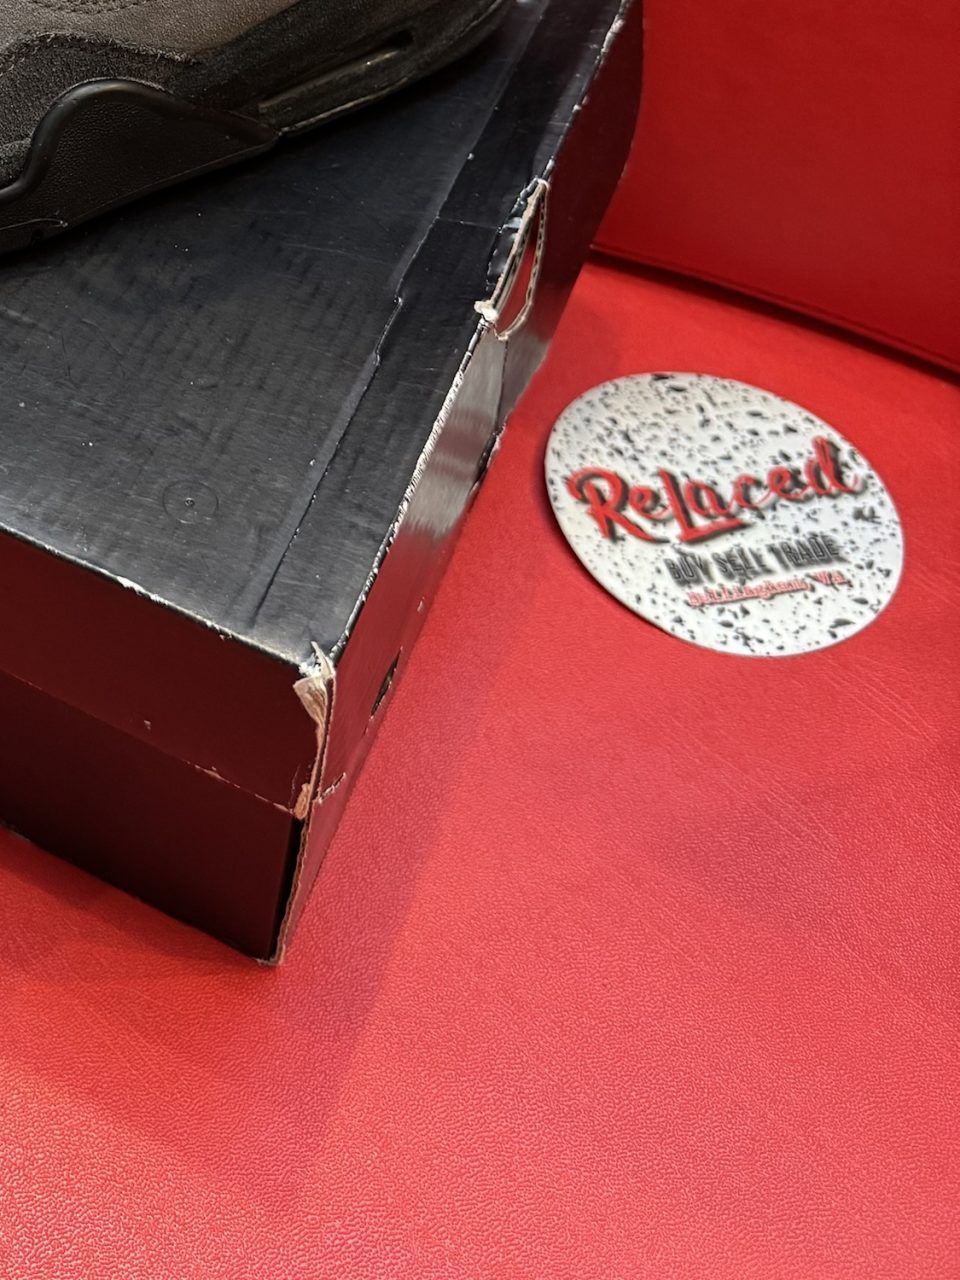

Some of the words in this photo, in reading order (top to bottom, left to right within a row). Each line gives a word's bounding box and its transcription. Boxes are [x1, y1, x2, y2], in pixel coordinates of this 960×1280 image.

[663, 554, 709, 586] BUY
[711, 547, 772, 579] SELL
[766, 535, 843, 567] TRADE
